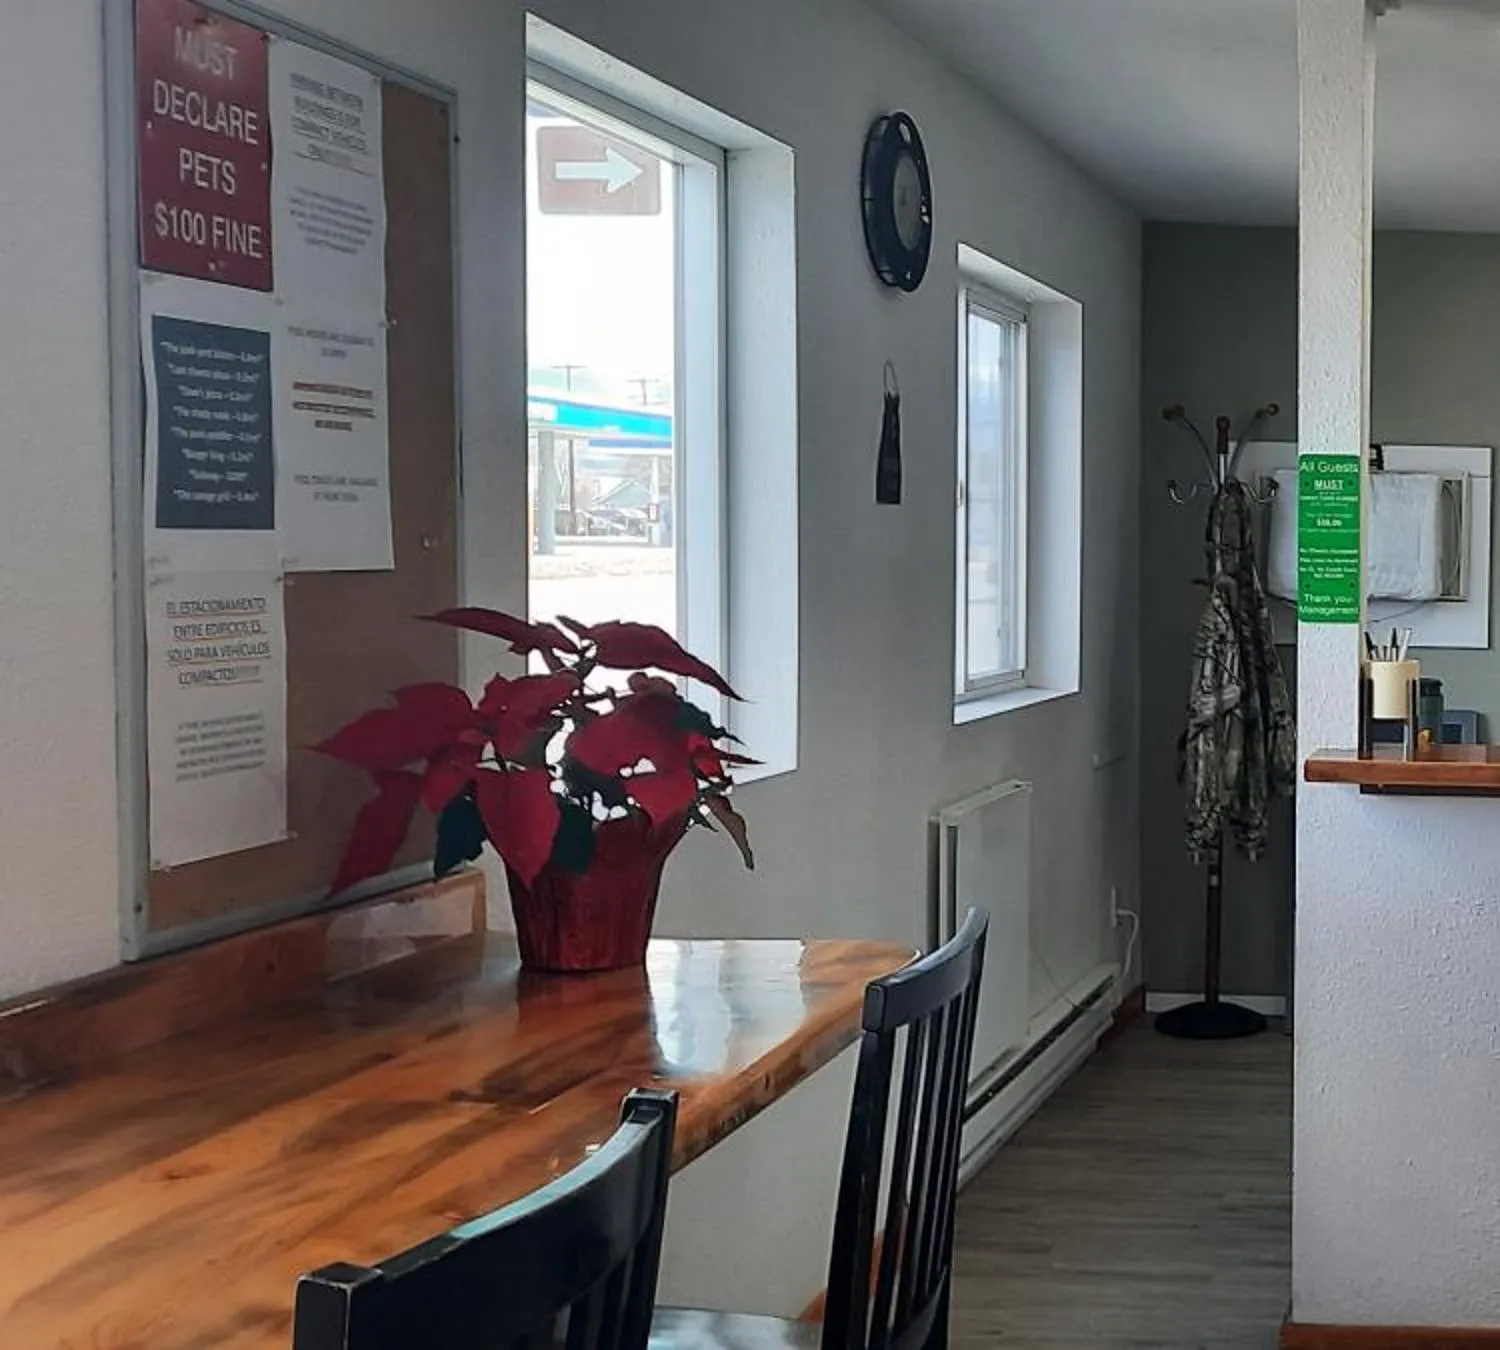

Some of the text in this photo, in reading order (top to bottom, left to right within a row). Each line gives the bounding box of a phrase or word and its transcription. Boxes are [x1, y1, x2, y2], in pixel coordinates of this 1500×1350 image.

[174, 26, 238, 80] MUST
[153, 79, 259, 145] DECLARE
[179, 148, 237, 195] PETS
[154, 201, 206, 246] $100
[212, 215, 264, 259] FINE
[1300, 461, 1358, 473] All Guests
[1314, 480, 1343, 490] MUST
[1300, 606, 1358, 616] Management
[1304, 594, 1330, 603] Thank
